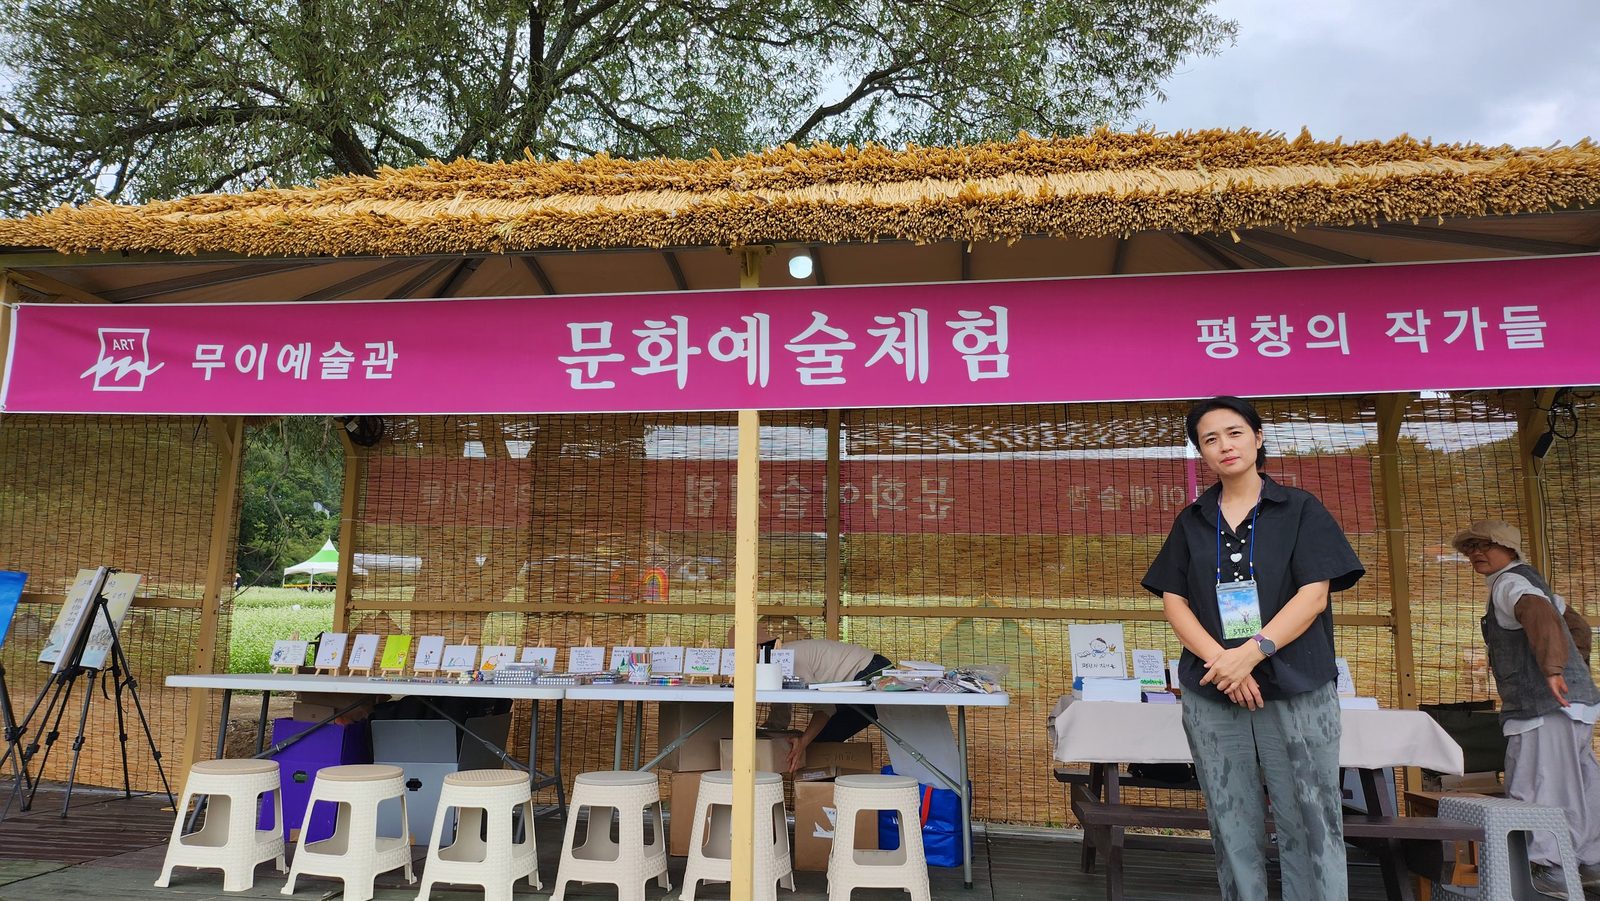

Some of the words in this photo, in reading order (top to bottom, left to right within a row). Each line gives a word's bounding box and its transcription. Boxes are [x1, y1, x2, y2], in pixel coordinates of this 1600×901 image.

[113, 338, 136, 351] ART
[557, 305, 1010, 390] 문화예술체험
[1196, 312, 1350, 359] 평창의
[1385, 305, 1547, 353] 작가들
[192, 341, 398, 380] 무이예술관
[1233, 626, 1254, 636] STAFF
